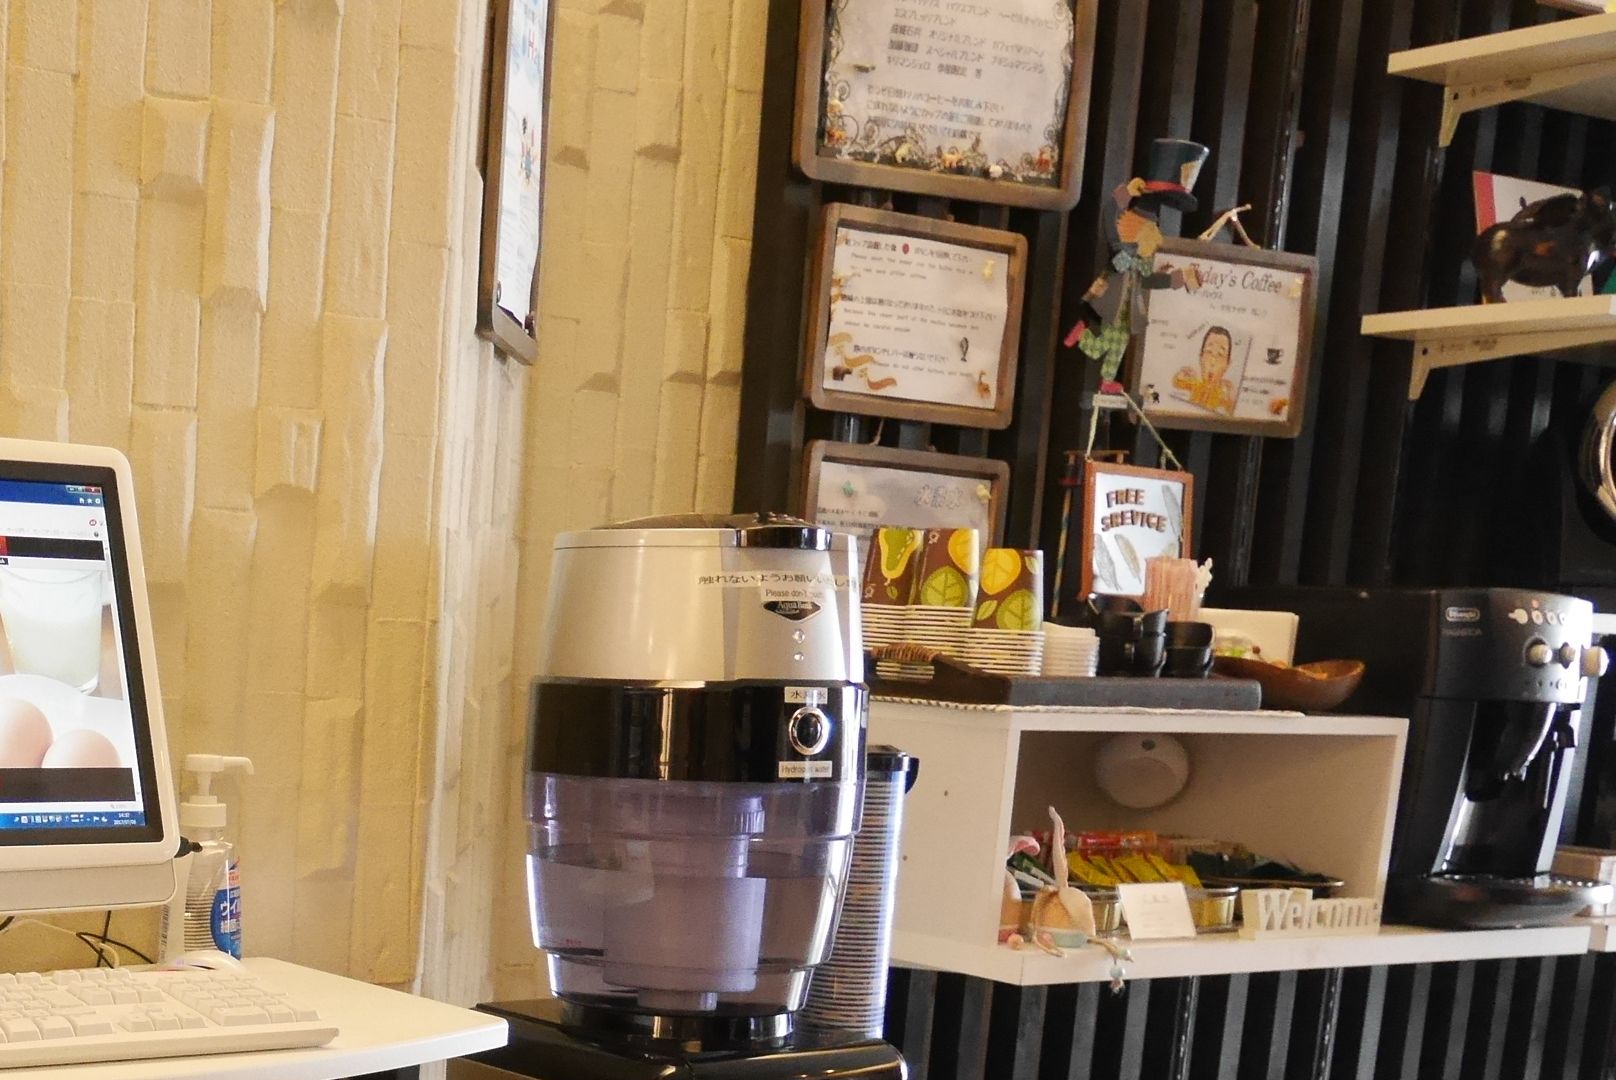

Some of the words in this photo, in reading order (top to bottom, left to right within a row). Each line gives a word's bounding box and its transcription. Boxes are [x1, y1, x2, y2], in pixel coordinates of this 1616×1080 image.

[1241, 270, 1282, 293] Coffee
[1106, 488, 1145, 508] FREE
[1101, 510, 1167, 532] SREVICE
[766, 589, 789, 598] Please
[790, 689, 825, 699] 水水
